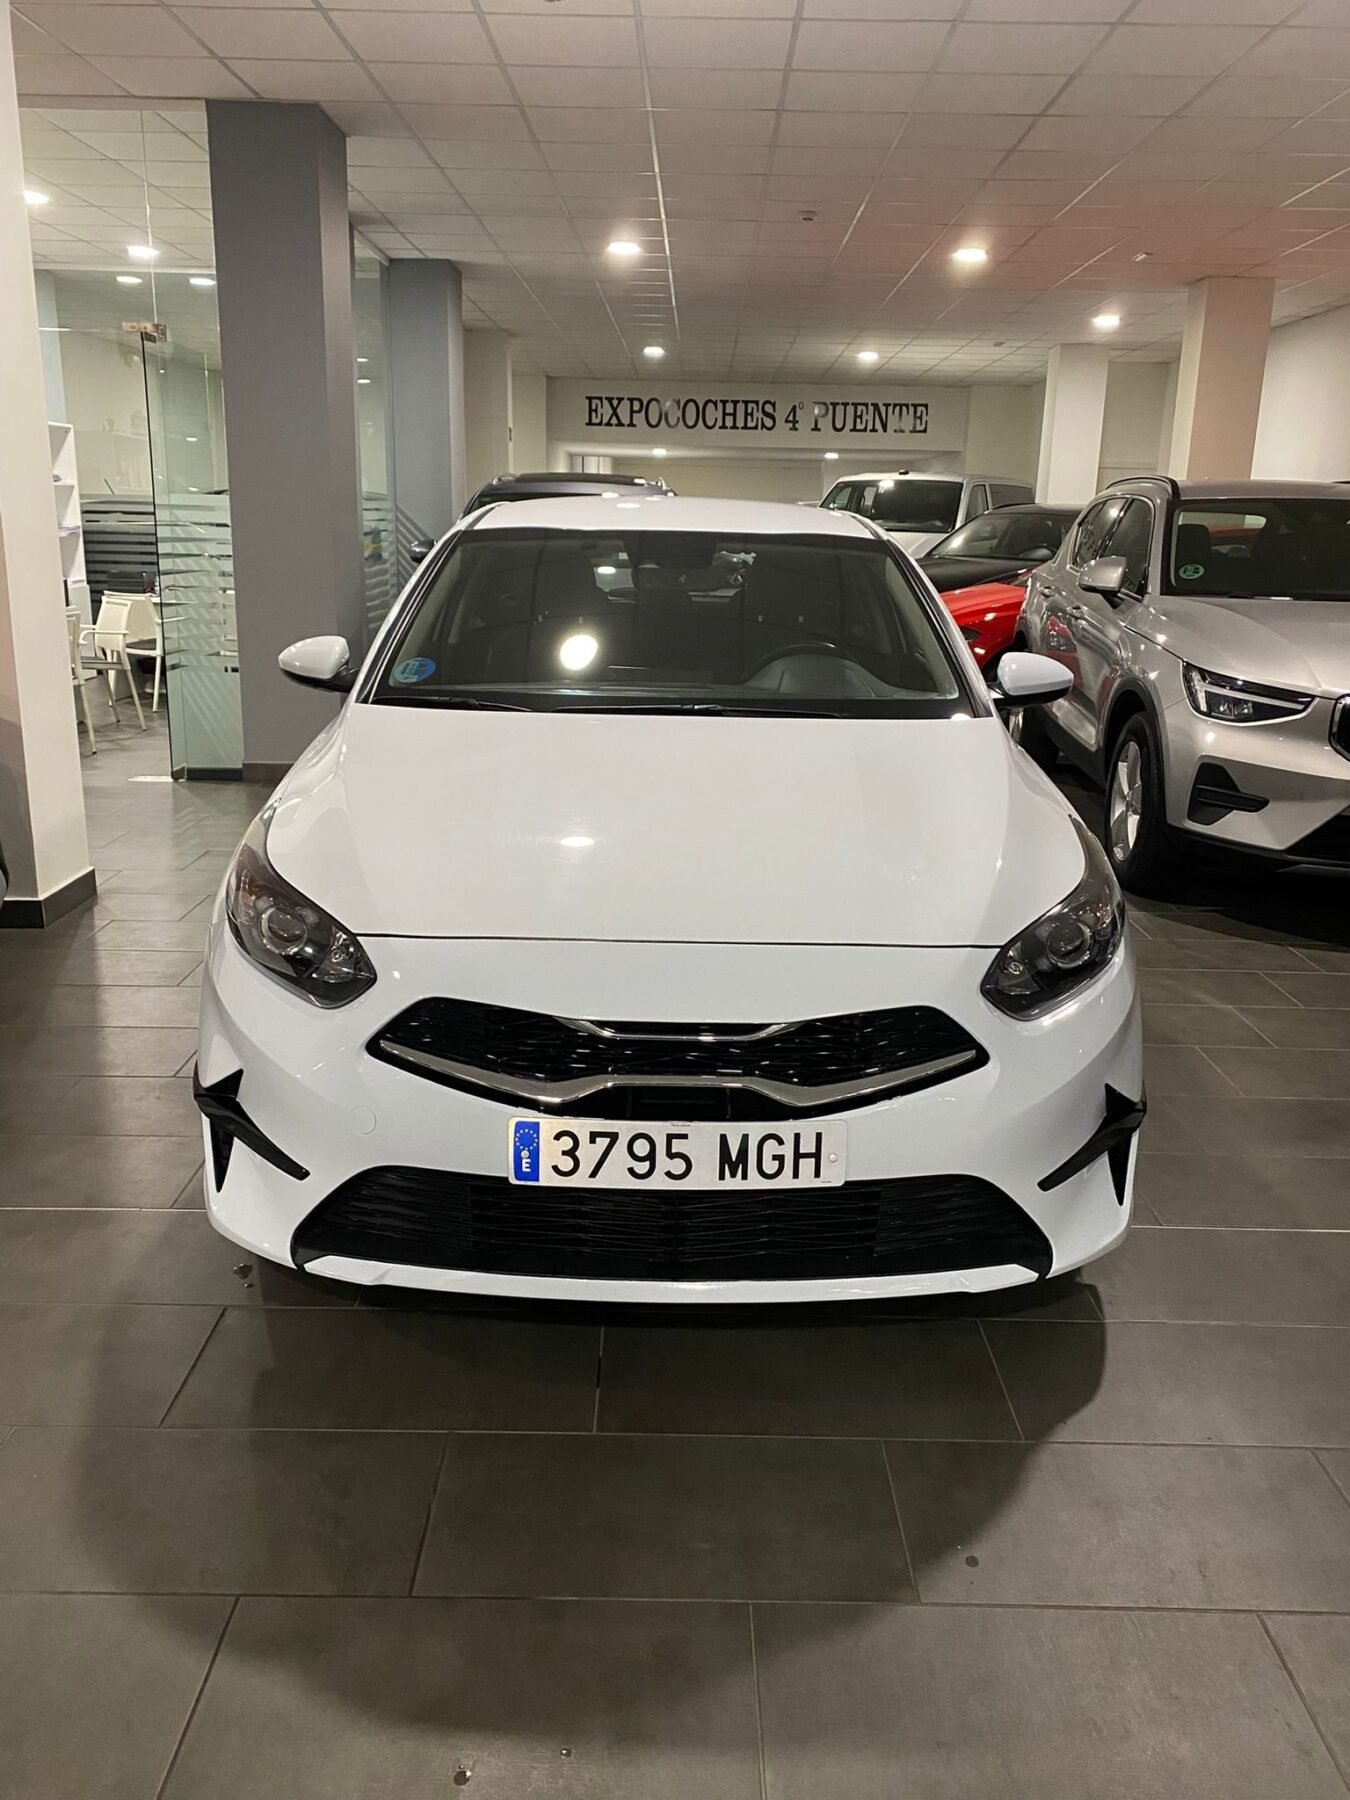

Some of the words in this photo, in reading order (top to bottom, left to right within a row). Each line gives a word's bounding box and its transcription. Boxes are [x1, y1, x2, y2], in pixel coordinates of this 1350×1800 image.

[585, 396, 776, 431] EXPOCOCHES
[811, 401, 929, 433] PUENTE
[521, 1159, 531, 1173] E
[551, 1130, 693, 1181] 3795
[718, 1131, 823, 1181] MGH
